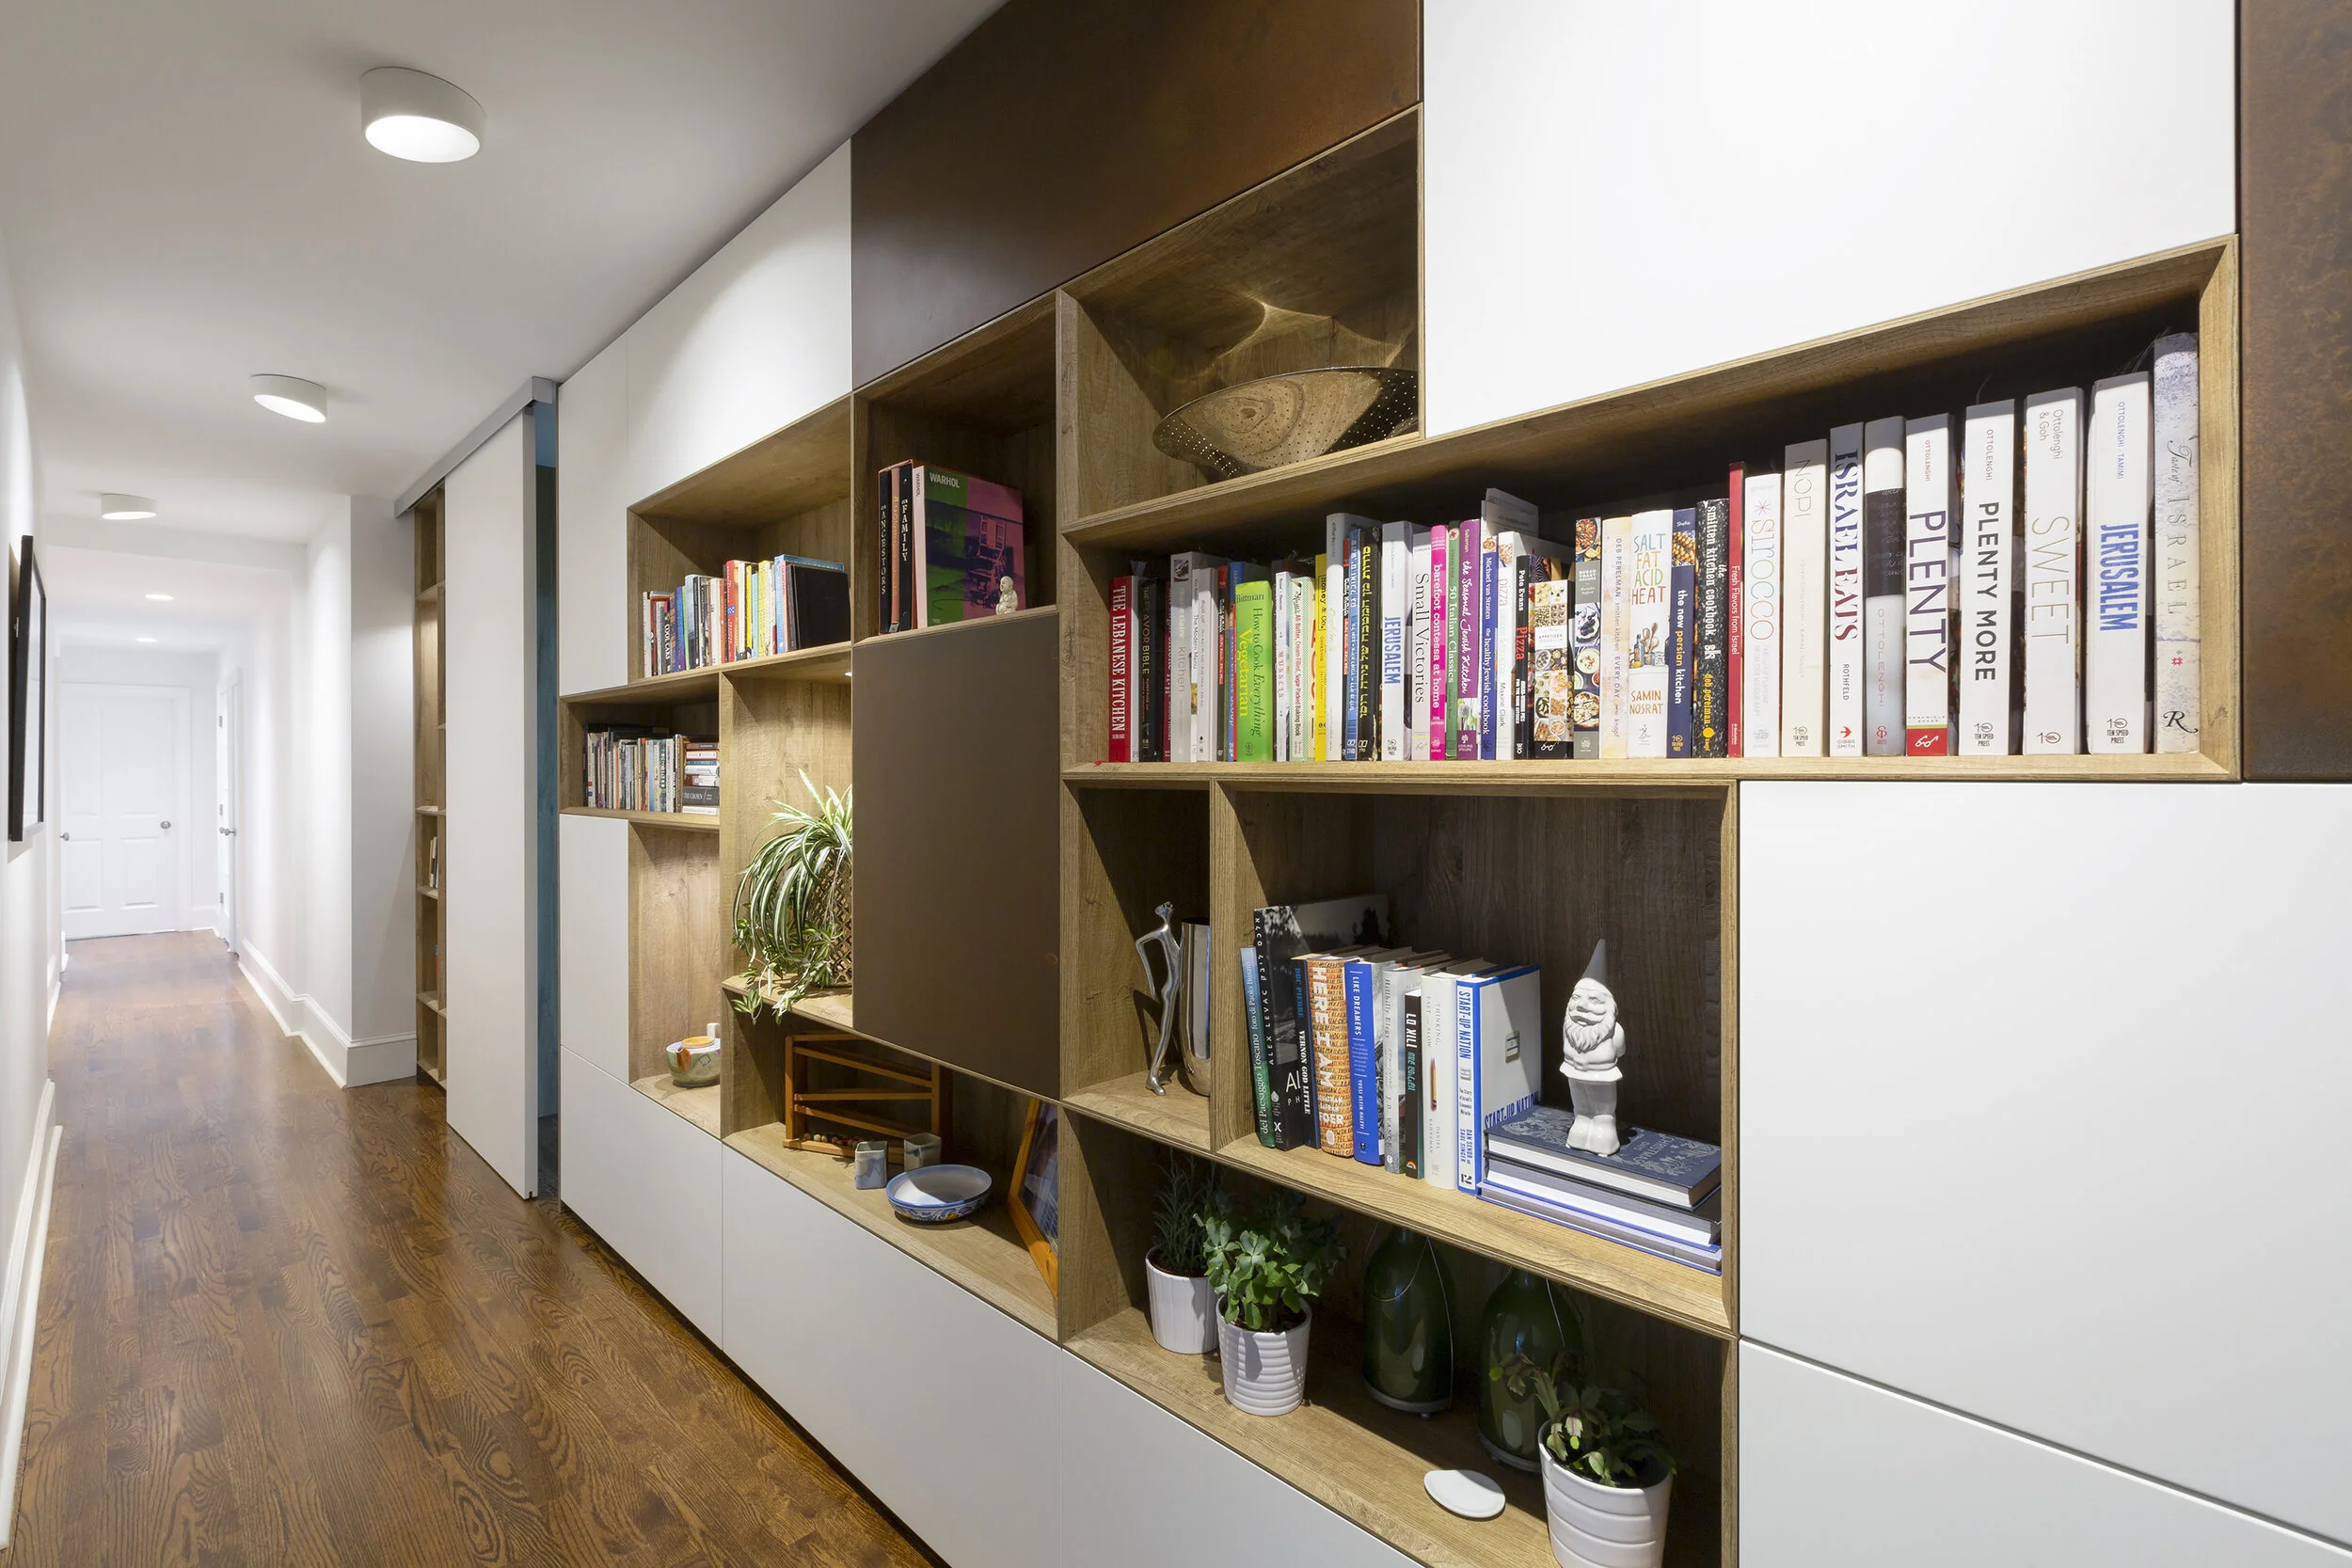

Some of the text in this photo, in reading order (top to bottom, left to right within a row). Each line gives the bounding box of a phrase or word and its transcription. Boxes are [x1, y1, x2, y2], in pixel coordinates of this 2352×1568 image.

[2039, 411, 2048, 441] & Goh
[2049, 408, 2064, 460] Ottolenghi
[2116, 401, 2126, 480] OTTOLENGHI TAMIMI
[1985, 429, 1994, 481] OTTOLENGHI
[929, 472, 961, 488] WARHOL
[1794, 459, 1812, 517] NOPI
[900, 504, 909, 562] FAMILY
[1633, 532, 1667, 551] SALT
[1834, 449, 1859, 641] ISRAEL EATS
[1485, 557, 1493, 579] Michael
[1634, 568, 1664, 587] ACID
[1636, 551, 1659, 569] FAT
[1705, 505, 1720, 637] smitten kitchen cookbook
[1718, 564, 1727, 579] the
[2099, 523, 2139, 631] JERUSALEM
[2167, 496, 2190, 615] ISRAEL
[1112, 586, 1127, 611] THE
[1236, 594, 1264, 605] Bittman
[1433, 564, 1443, 610] barefoot
[1448, 585, 1457, 600] 50
[1497, 578, 1511, 607] pizza
[1630, 585, 1666, 605] HEAT
[1750, 519, 1775, 641] sirocco
[1909, 510, 1947, 673] PLENTY
[1975, 501, 2000, 681] PLENTY MORE
[2031, 516, 2070, 644] SWEET
[1448, 603, 1457, 637] Italian
[1460, 561, 1474, 694] the Seasonal Jewish Kitchen
[1485, 596, 1493, 620] Straten
[1516, 588, 1529, 660] Evans Pizza
[1731, 565, 1740, 656] Fresh Flavors from Israel
[1112, 615, 1127, 675] LEBANESE
[1360, 545, 1373, 720] סודות מן המטבח של נירה רוסו
[1384, 616, 1401, 685] JERUSALEM
[1415, 573, 1430, 704] Small Victories
[1433, 613, 1442, 662] contessa
[1483, 638, 1492, 667] healthy
[1613, 628, 1622, 652] kitchen
[1675, 590, 1687, 705] the new persian kitchen
[1142, 645, 1151, 674] BIBLE
[1176, 646, 1190, 692] kitchen
[1236, 628, 1252, 718] Vegetarian
[1250, 608, 1265, 738] How to Cook Everything
[1433, 664, 1442, 675] at
[1448, 641, 1457, 684] Classics
[1483, 667, 1493, 693] Jewish
[1877, 609, 1885, 707] OTTOLENGHI
[1432, 678, 1442, 708] home
[1630, 690, 1662, 702] SAMIN
[1703, 673, 1713, 724] deb perelman
[1842, 663, 1851, 701] ROTHFELD
[1112, 677, 1126, 732] KITCHEN
[1294, 705, 1302, 727] Baking
[1482, 694, 1491, 735] cookbook
[1629, 704, 1663, 715] NOSRAT
[1612, 719, 1621, 738] knopf
[1254, 916, 1267, 982] אלכס ליבק
[1247, 986, 1255, 1006] Paolo
[1249, 1006, 1256, 1015] di
[1352, 975, 1362, 1036] LIKE DREAMERS
[1263, 990, 1274, 1065] ALEX LEVAC
[1312, 966, 1334, 1088] HERE I AM
[1406, 1013, 1417, 1025] רם
[1406, 1028, 1417, 1048] אורן
[1458, 990, 1471, 1060] START-UP NATION
[1252, 1033, 1262, 1071] Toscano
[1298, 1030, 1307, 1064] VERNON
[1254, 1072, 1267, 1117] Paesaggio
[1260, 1118, 1269, 1134] del
[1318, 1111, 1343, 1126] FOER
